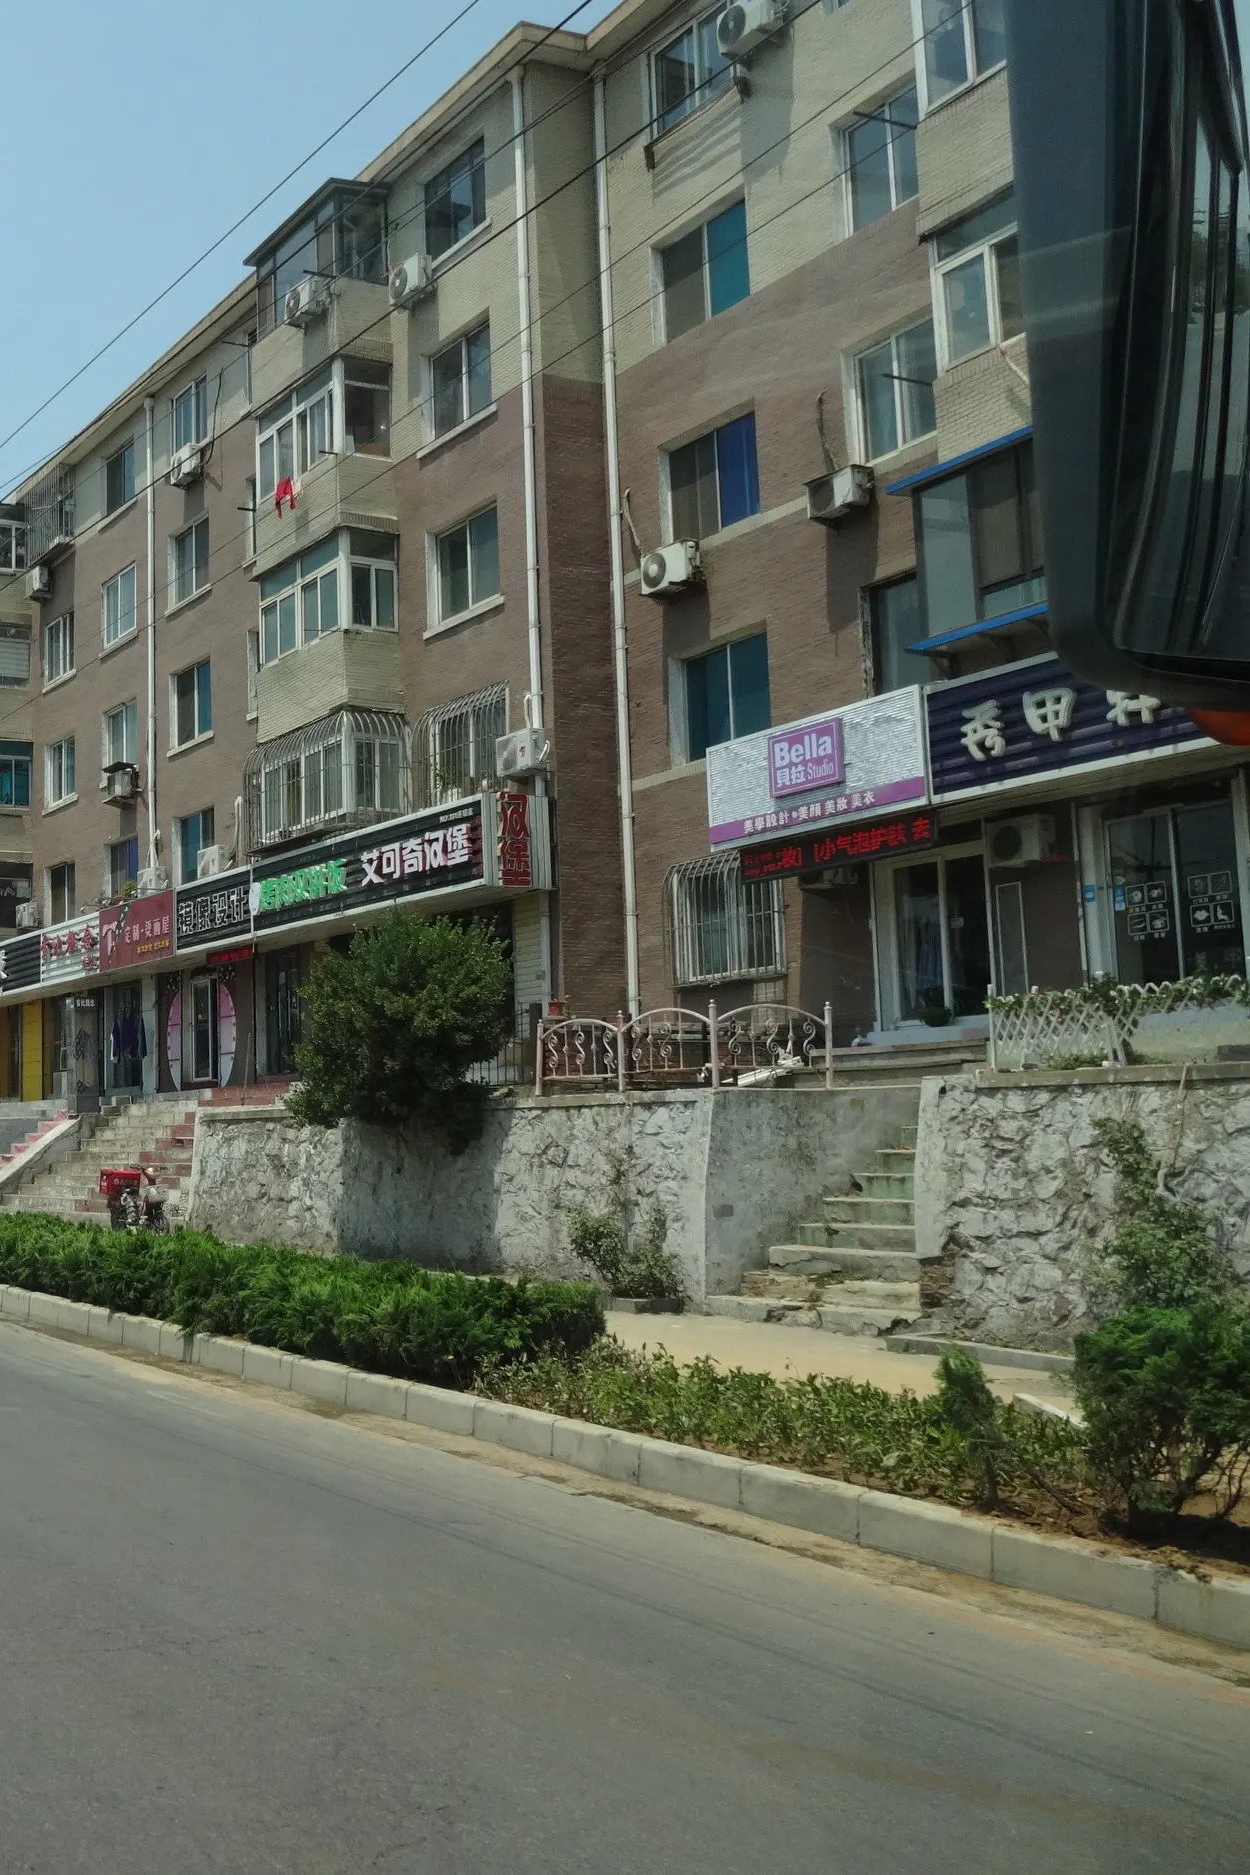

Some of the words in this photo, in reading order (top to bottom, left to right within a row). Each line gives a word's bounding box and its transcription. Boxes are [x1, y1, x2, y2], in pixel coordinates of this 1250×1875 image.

[773, 732, 832, 768] Bella
[776, 764, 806, 788] 貝拉
[807, 758, 834, 780] Studio
[361, 823, 472, 887] 艾可奇汉堡
[497, 792, 533, 887] 汉堡
[178, 886, 248, 936] 镜像设计
